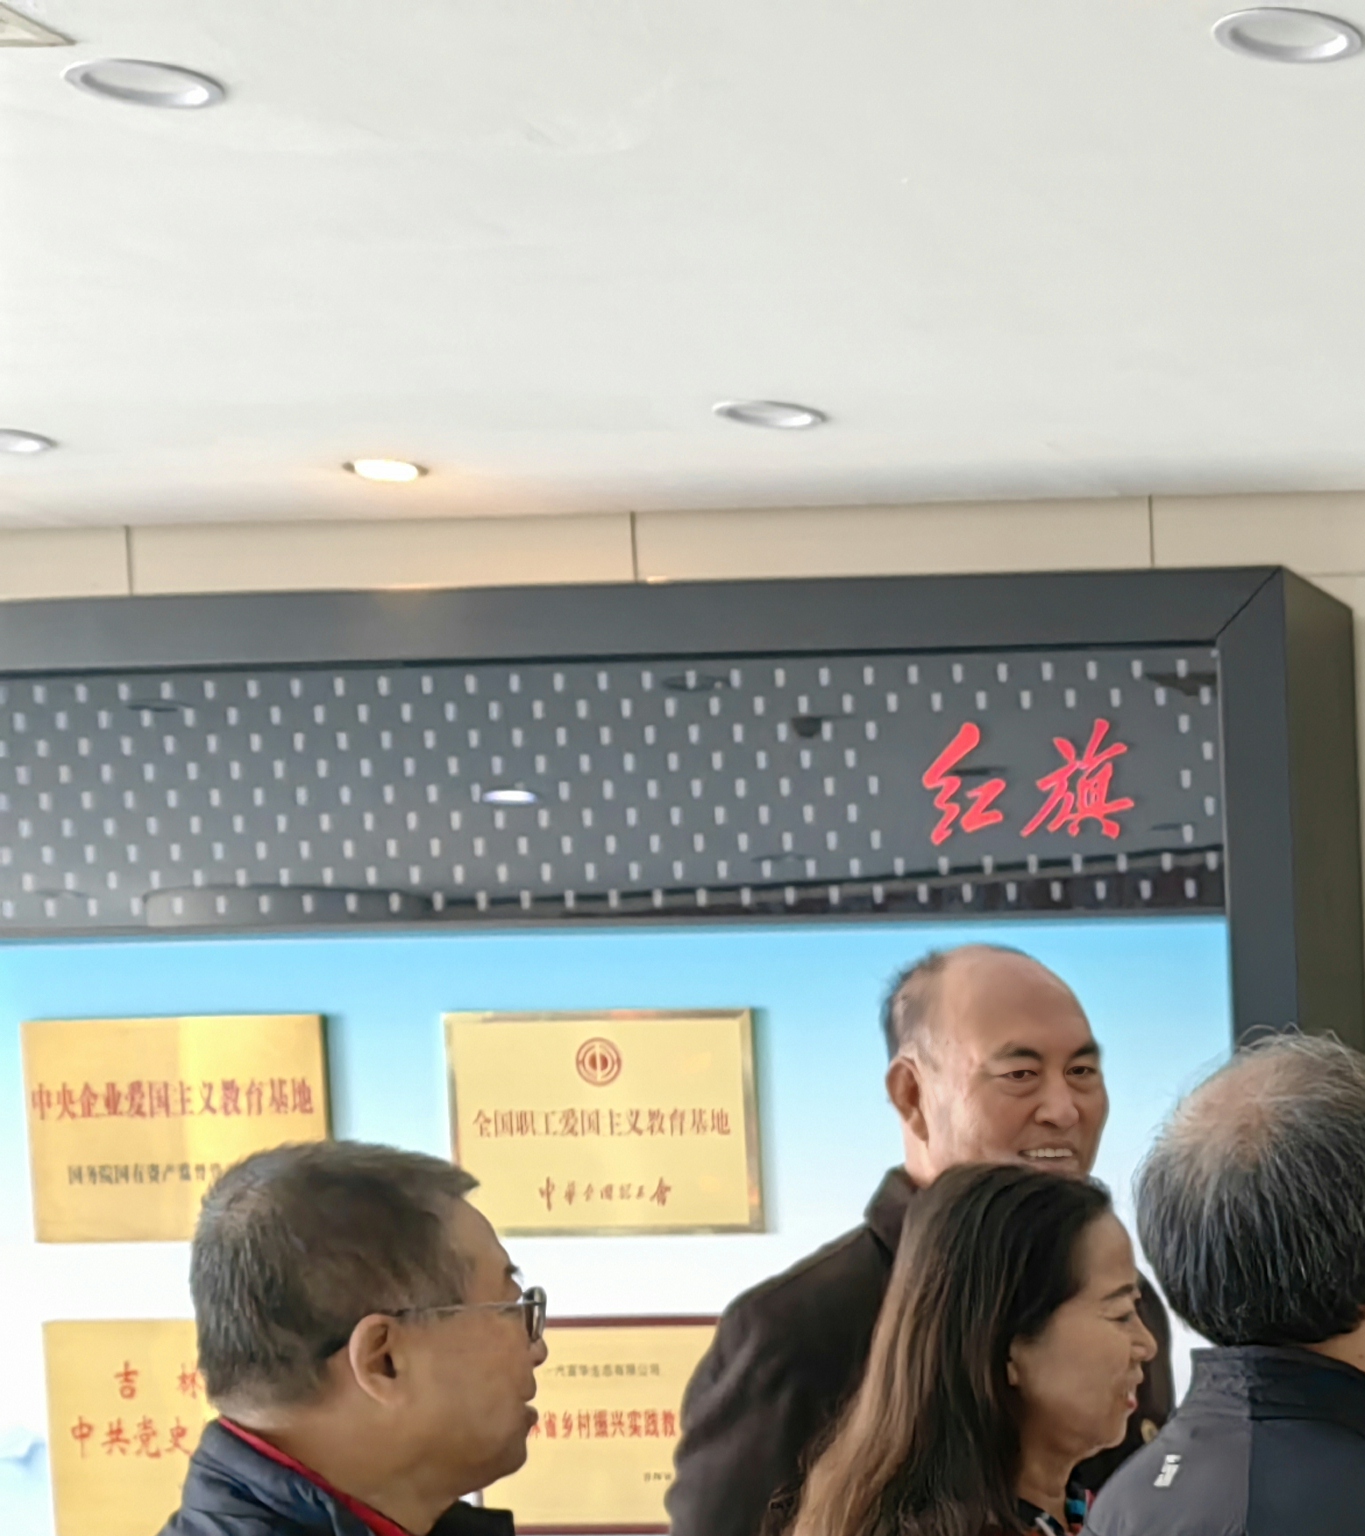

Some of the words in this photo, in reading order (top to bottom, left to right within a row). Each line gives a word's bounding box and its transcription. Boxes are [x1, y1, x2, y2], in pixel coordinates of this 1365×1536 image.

[922, 718, 1134, 846] 红旗
[31, 1077, 314, 1121] 中央企业爱国主义教育基地
[473, 1107, 732, 1137] 全国职工爱国主义教育基地
[71, 1416, 193, 1459] 中共党史
